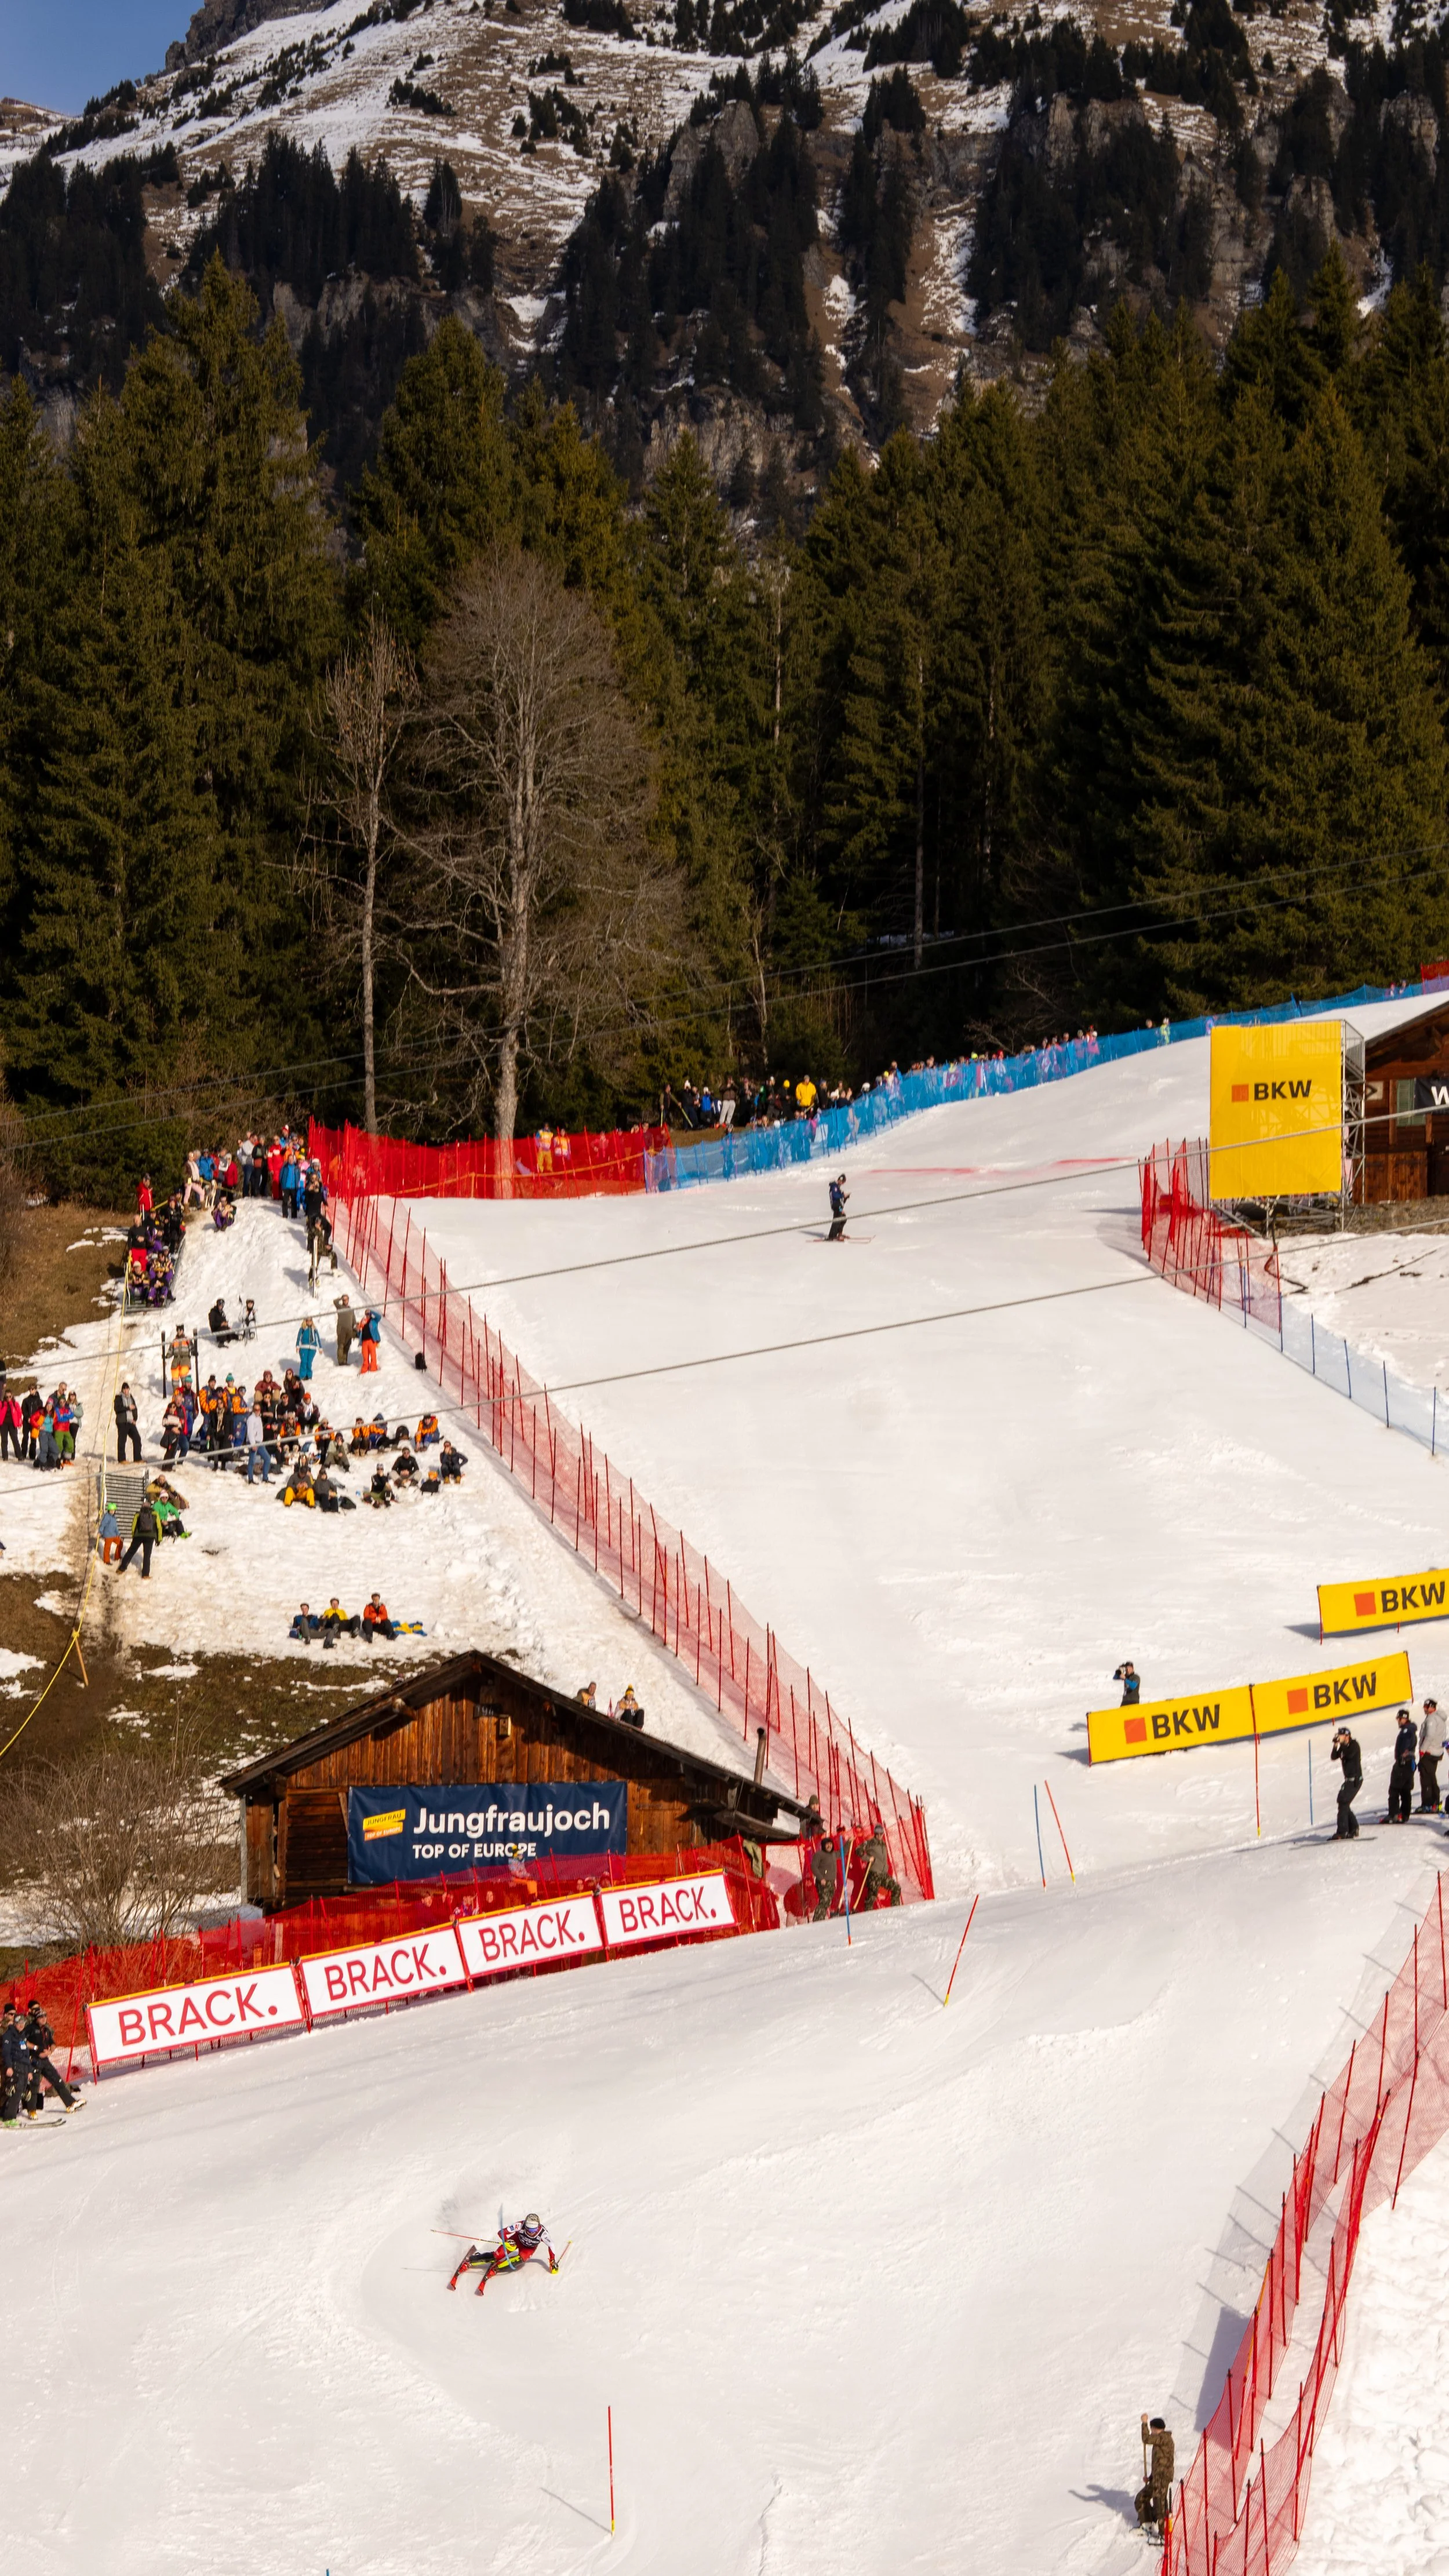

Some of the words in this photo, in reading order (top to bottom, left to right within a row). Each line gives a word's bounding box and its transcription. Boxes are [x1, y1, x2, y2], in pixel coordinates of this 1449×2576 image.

[1254, 1080, 1312, 1101] BKW
[1381, 1581, 1445, 1613] BKW
[1313, 1672, 1377, 1709] BKW
[1152, 1704, 1220, 1739] BKW
[367, 1813, 402, 1826] JUNGFRAU
[383, 1826, 401, 1835] EUROPE
[413, 1802, 610, 1839] Jungfraujoch
[412, 1844, 445, 1859] TOP
[448, 1843, 470, 1859] OF
[474, 1842, 537, 1858] EUROPE
[618, 1886, 717, 1933] BRACK.
[478, 1910, 585, 1962] BRACK.
[324, 1943, 447, 2002] BRACK.
[118, 1983, 278, 2046] BRACK.
